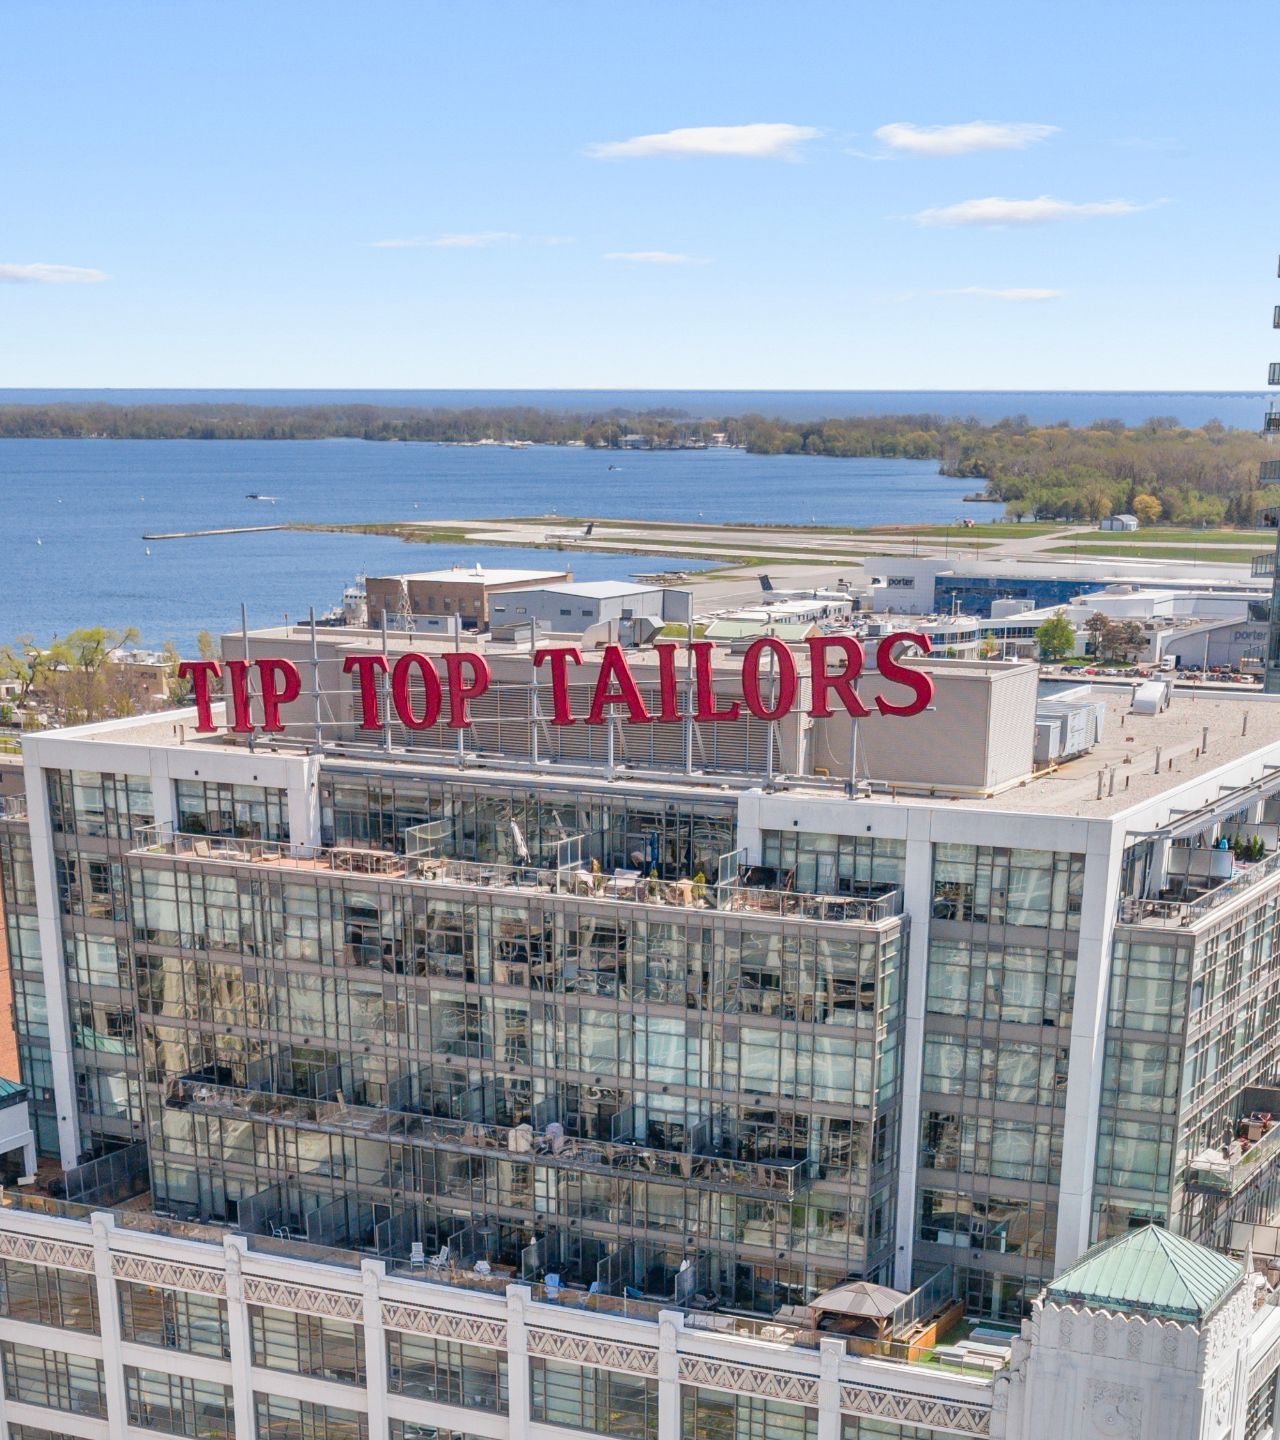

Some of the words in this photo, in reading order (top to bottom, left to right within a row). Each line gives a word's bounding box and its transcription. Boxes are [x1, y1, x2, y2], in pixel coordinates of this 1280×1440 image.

[888, 578, 913, 587] porter
[1234, 630, 1267, 641] porter
[178, 658, 301, 733] TIP
[343, 652, 491, 730] TOP
[533, 632, 935, 726] TAILORS
